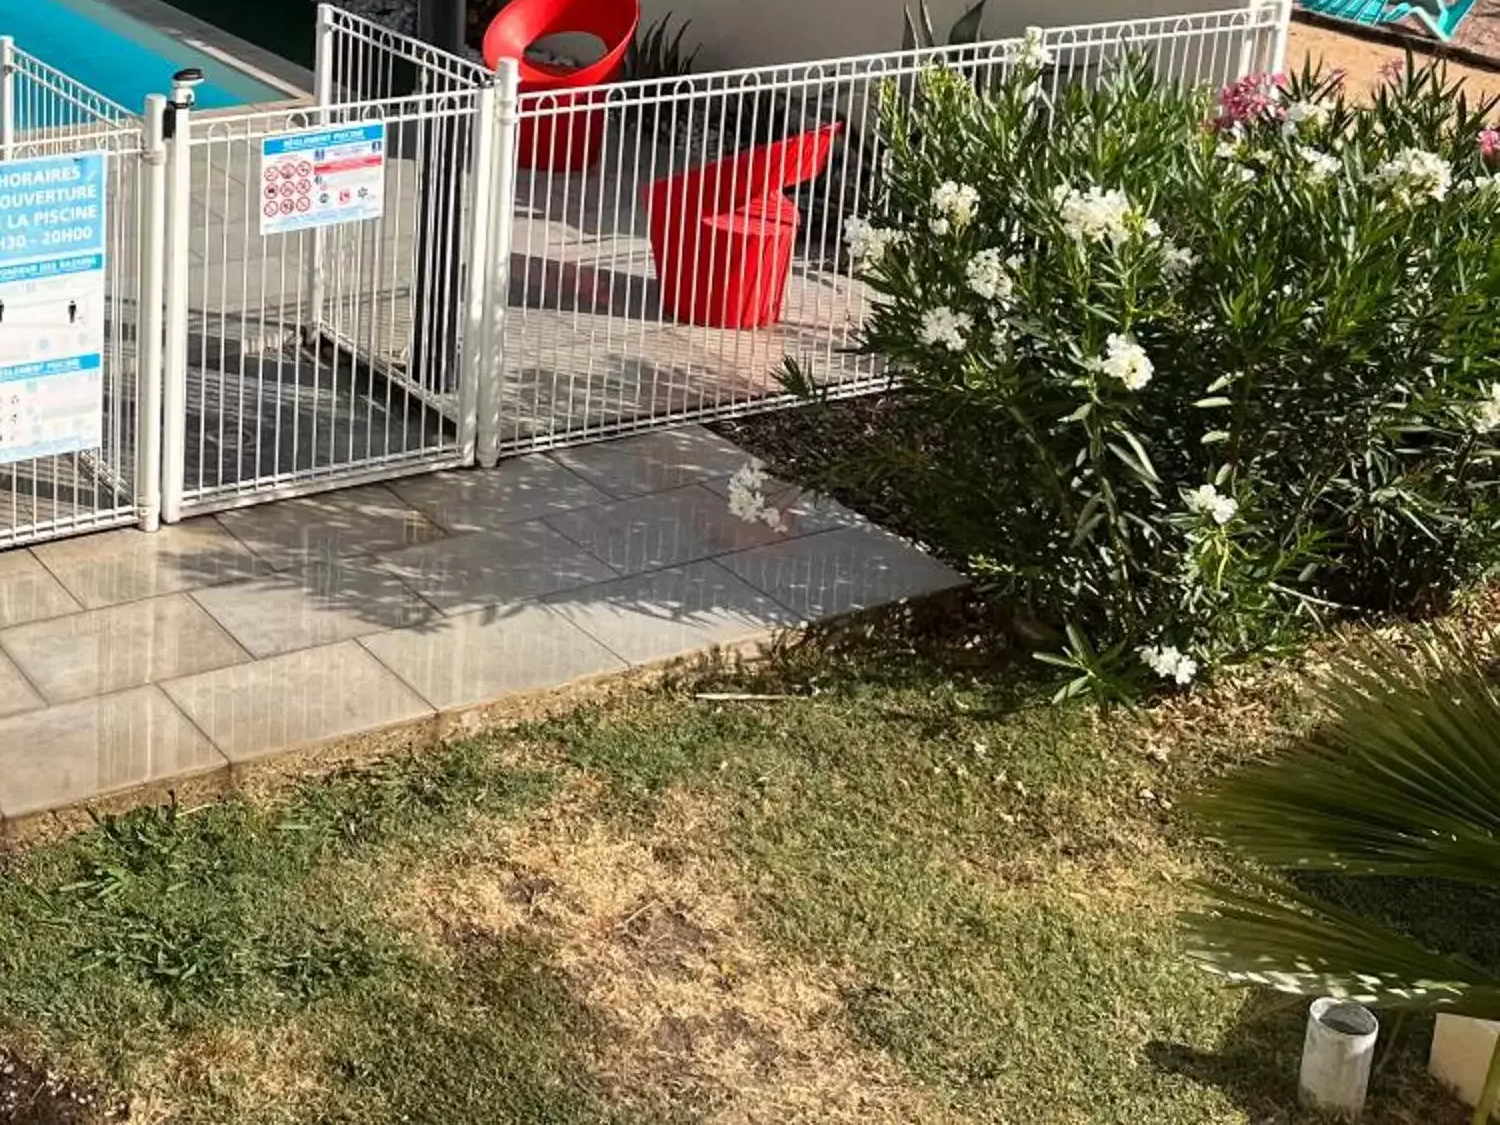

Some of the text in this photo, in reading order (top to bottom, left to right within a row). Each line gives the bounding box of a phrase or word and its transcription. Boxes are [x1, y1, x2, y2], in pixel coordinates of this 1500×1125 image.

[8, 214, 29, 229] LA
[33, 205, 97, 226] PISCINE
[42, 226, 93, 246] 20H00
